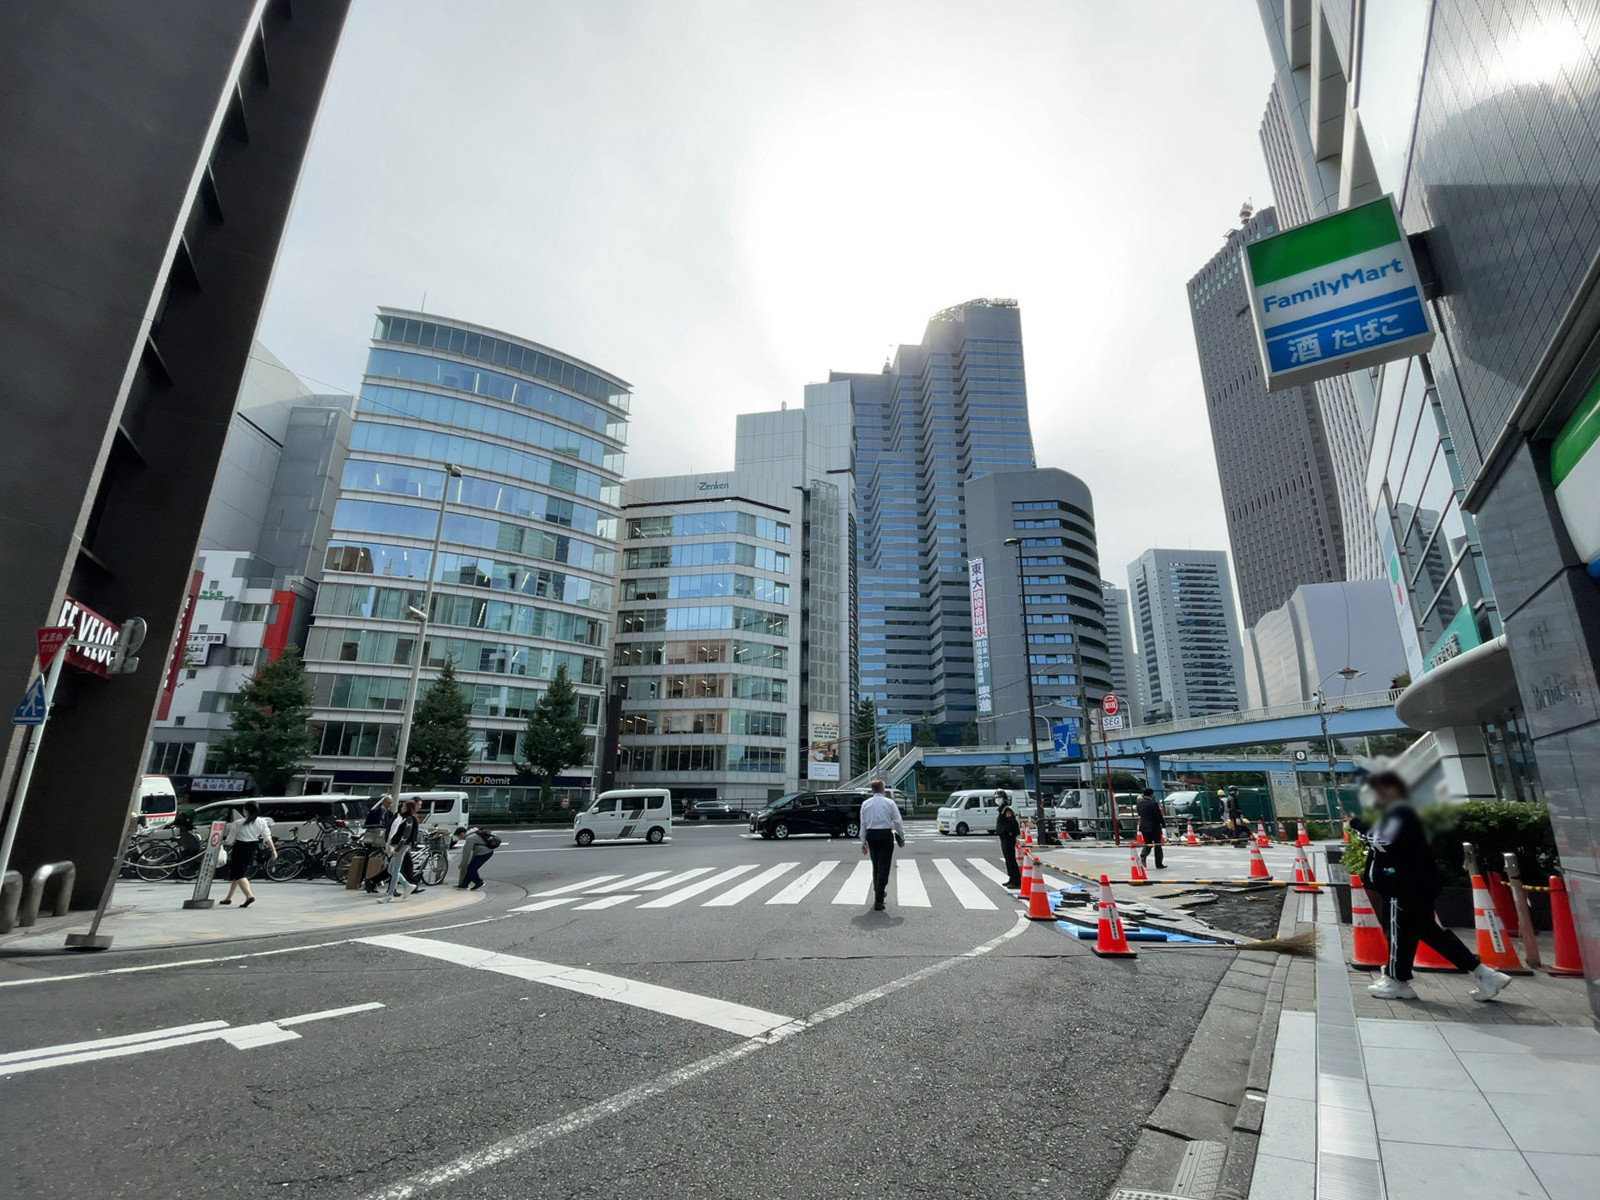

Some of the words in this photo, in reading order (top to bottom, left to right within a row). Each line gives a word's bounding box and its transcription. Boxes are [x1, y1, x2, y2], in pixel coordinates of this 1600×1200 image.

[1263, 258, 1404, 313] FamilyMart
[1287, 333, 1322, 364] 酒
[1331, 313, 1404, 350] たばこ
[698, 481, 729, 490] Zenken
[76, 610, 119, 667] VELOC
[1104, 716, 1120, 726] SEG
[460, 776, 482, 785] BDO
[483, 777, 510, 785] Remit
